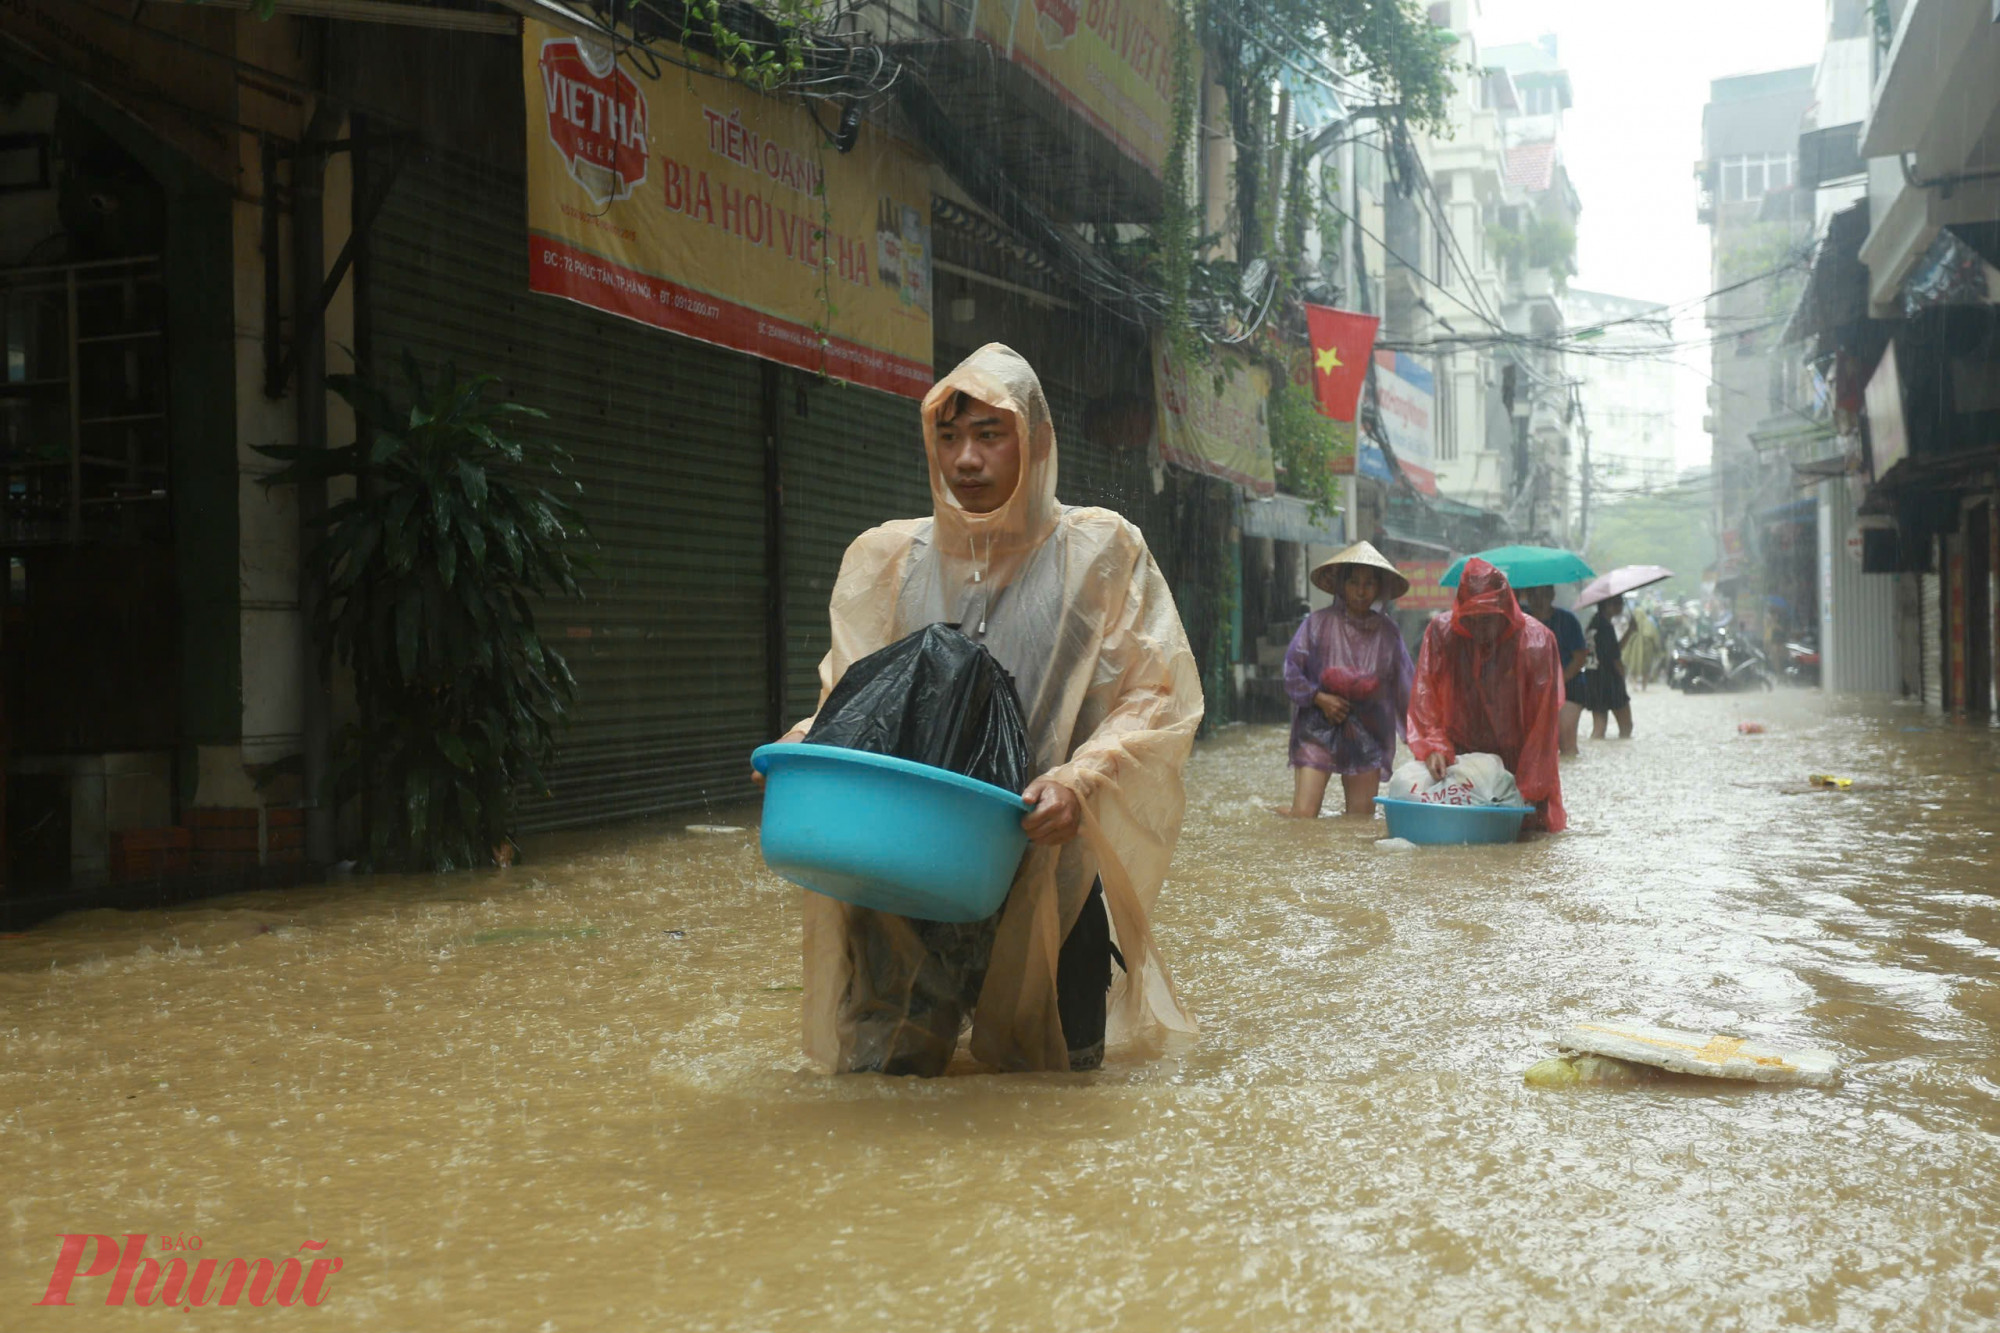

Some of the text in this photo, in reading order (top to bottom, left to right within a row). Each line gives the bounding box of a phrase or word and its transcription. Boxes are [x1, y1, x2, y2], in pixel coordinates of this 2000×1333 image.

[577, 137, 615, 163] BEER
[703, 106, 759, 172] TIẾN
[661, 156, 714, 226] BIA
[564, 257, 573, 272] 72
